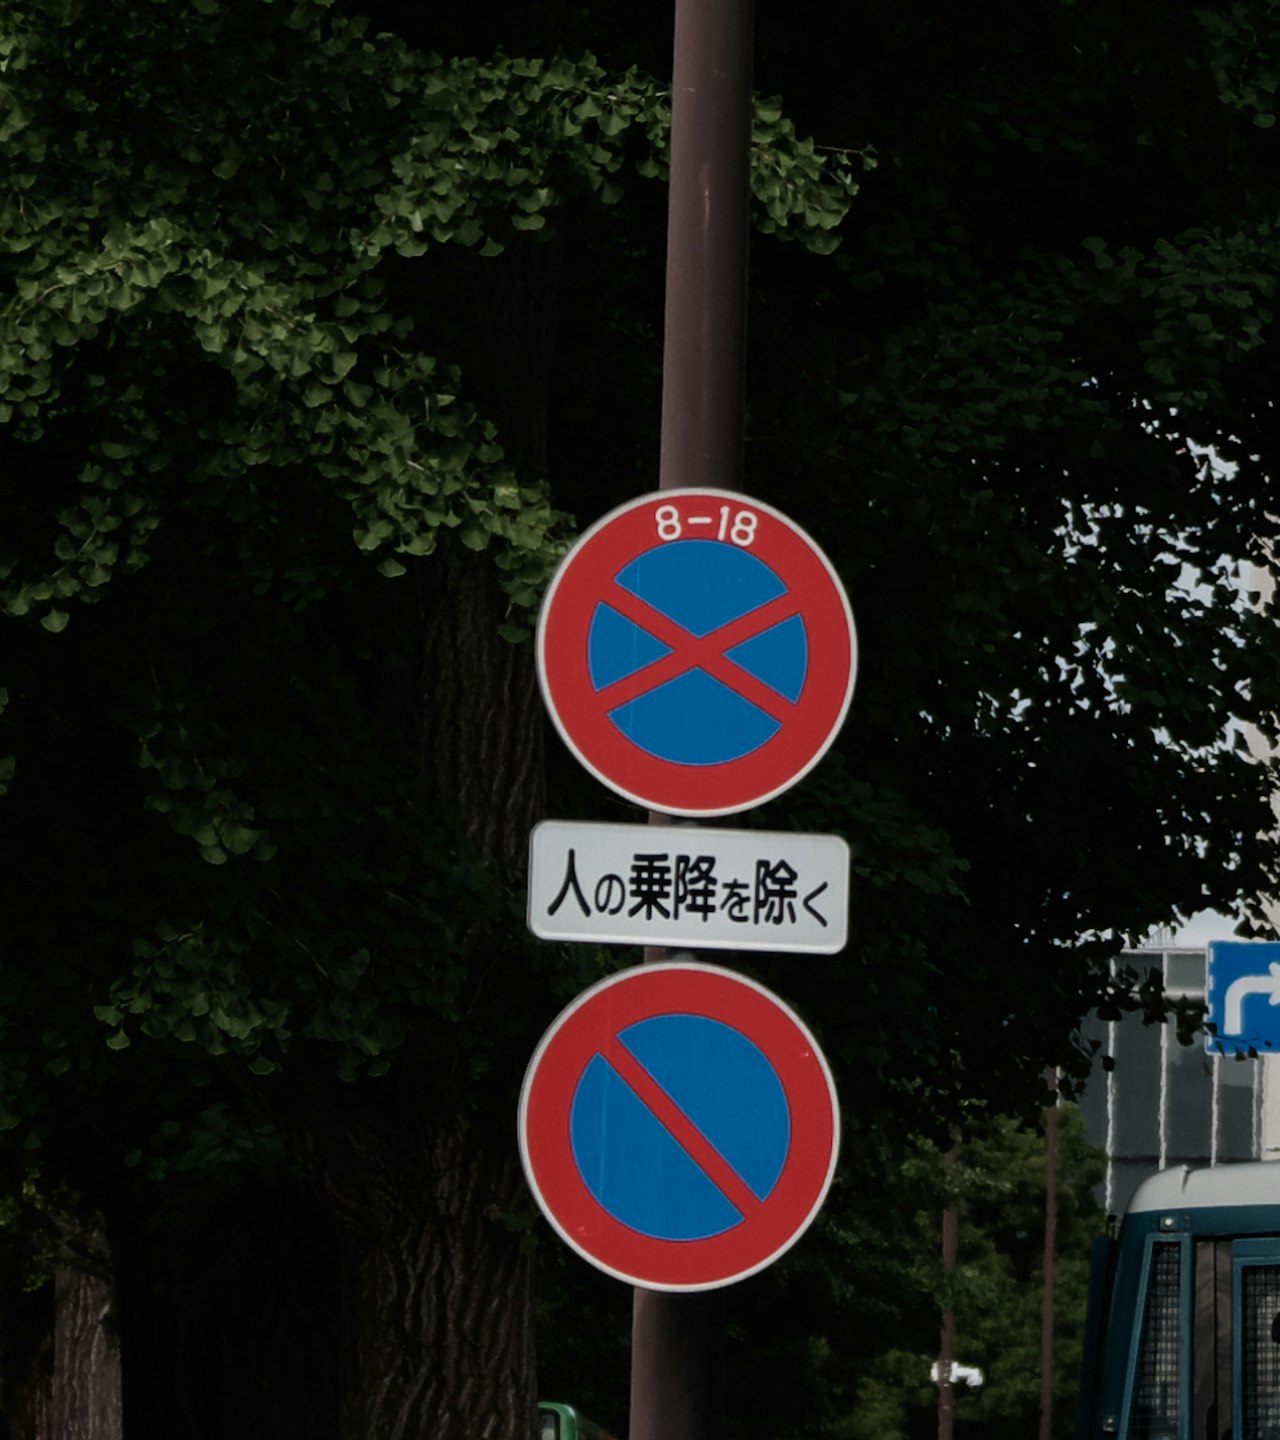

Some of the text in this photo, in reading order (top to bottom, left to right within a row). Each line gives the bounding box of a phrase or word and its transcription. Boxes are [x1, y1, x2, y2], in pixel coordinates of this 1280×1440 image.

[655, 505, 757, 547] 8-18
[548, 848, 828, 927] 人の乗降を除く
